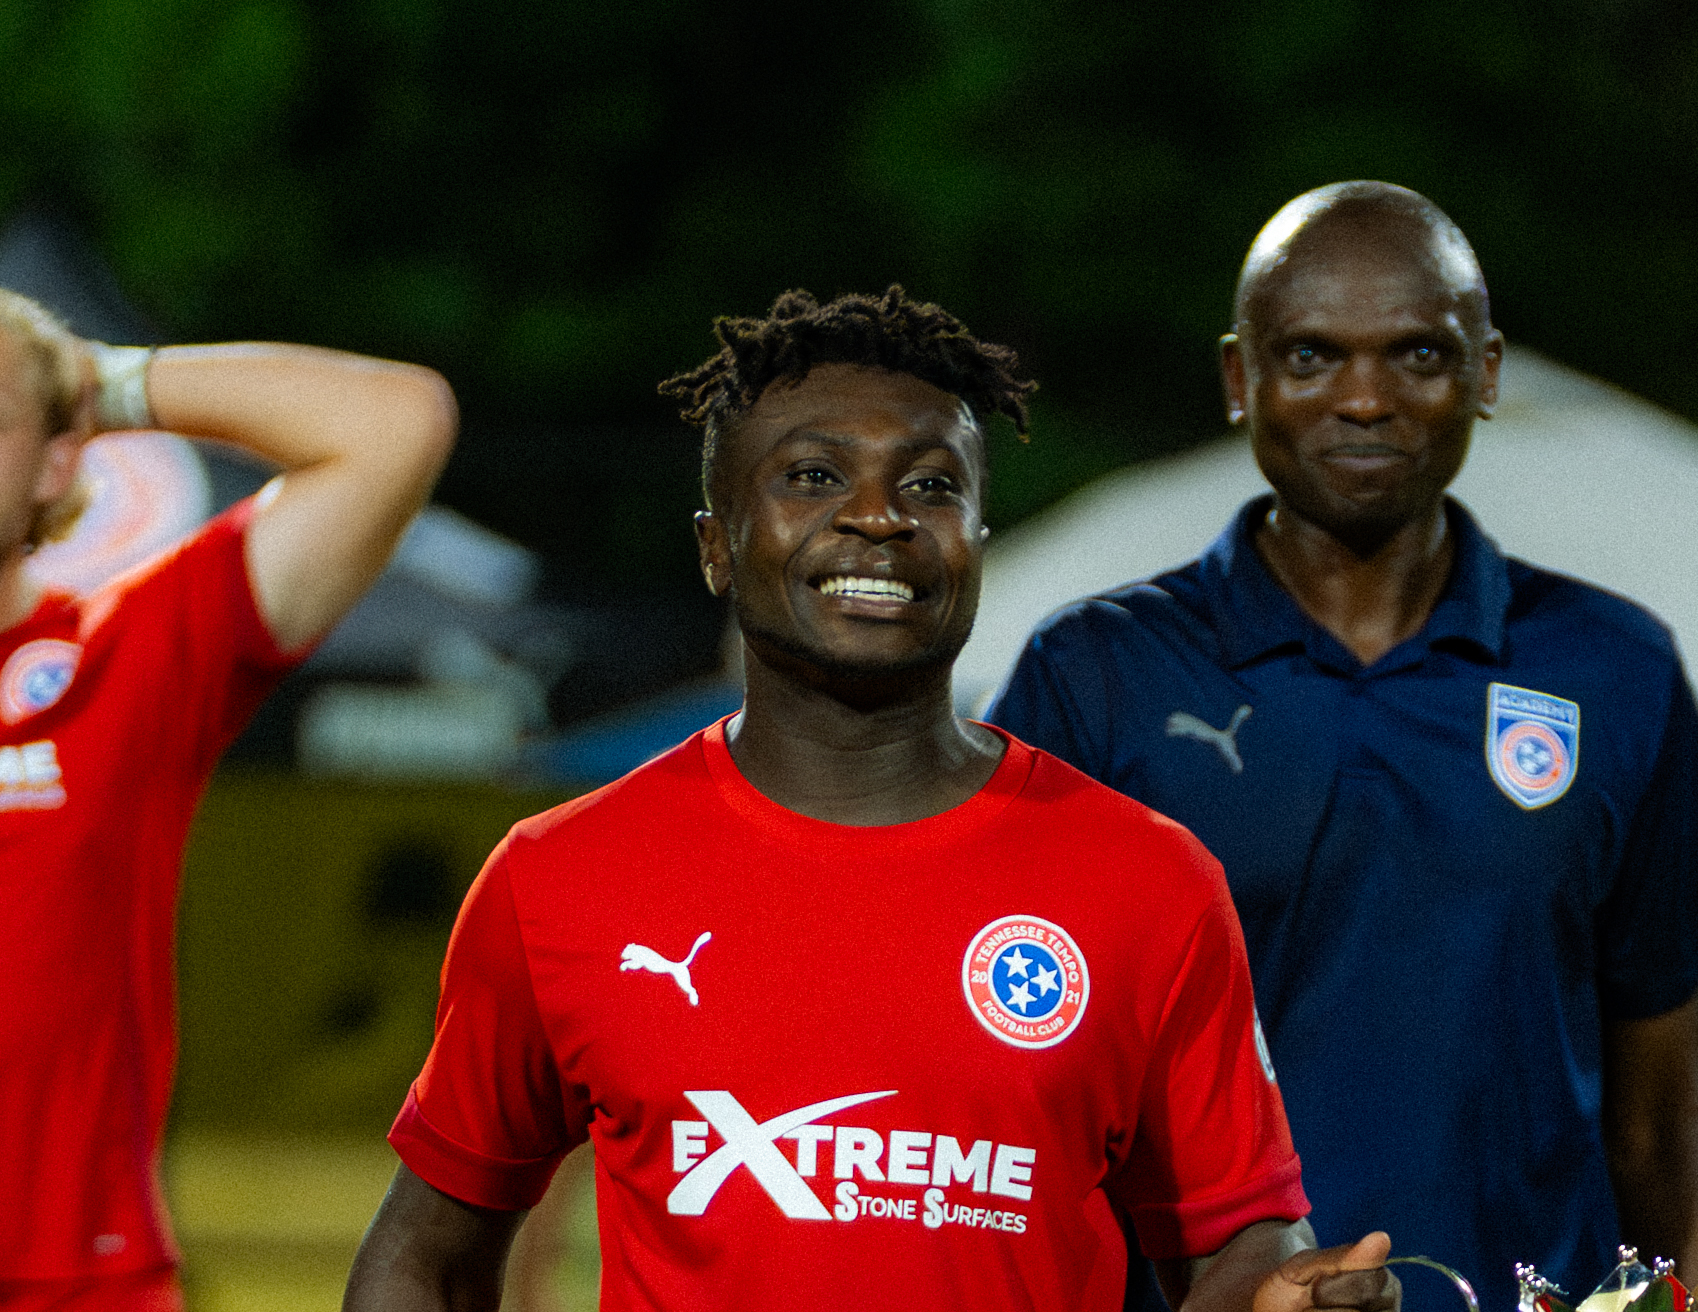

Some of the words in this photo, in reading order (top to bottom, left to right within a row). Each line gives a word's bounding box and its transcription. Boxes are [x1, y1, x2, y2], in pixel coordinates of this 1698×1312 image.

[975, 925, 1045, 963] TENNESSEE
[1047, 933, 1080, 983] TEMPO
[970, 969, 988, 984] 20
[1066, 989, 1080, 1005] 21
[981, 999, 1037, 1037] FOOTBALL
[1037, 1016, 1066, 1036] CLUB
